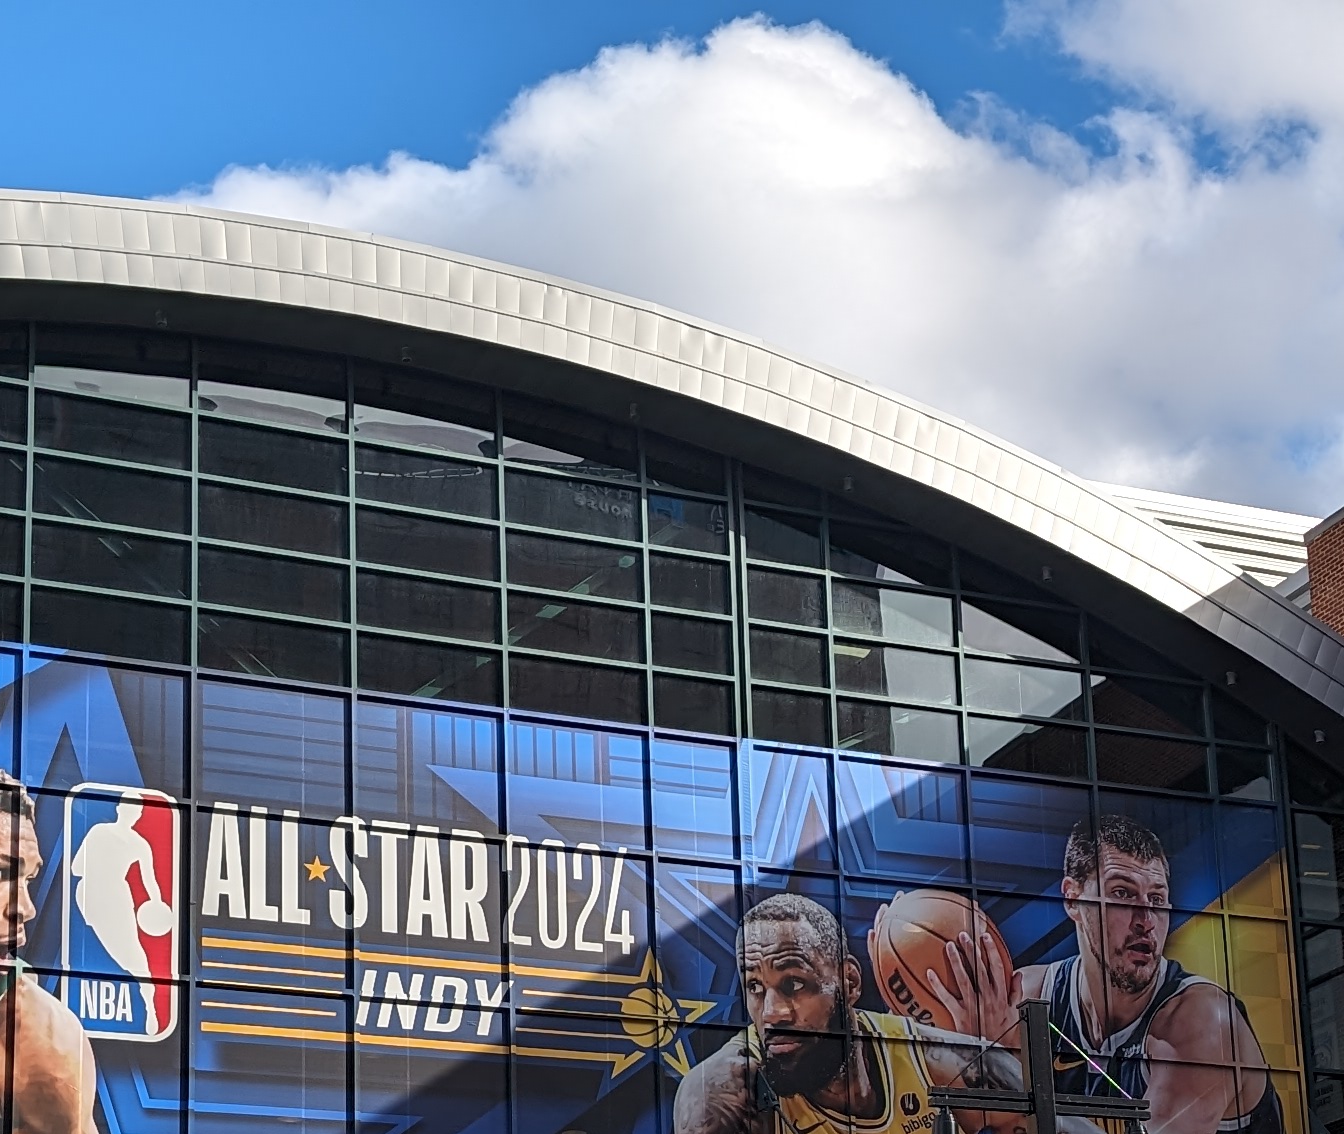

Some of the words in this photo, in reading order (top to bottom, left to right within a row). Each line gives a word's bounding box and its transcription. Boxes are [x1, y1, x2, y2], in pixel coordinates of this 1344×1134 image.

[506, 833, 635, 955] 2024
[79, 981, 133, 1023] NBA
[356, 968, 518, 1036] INDY
